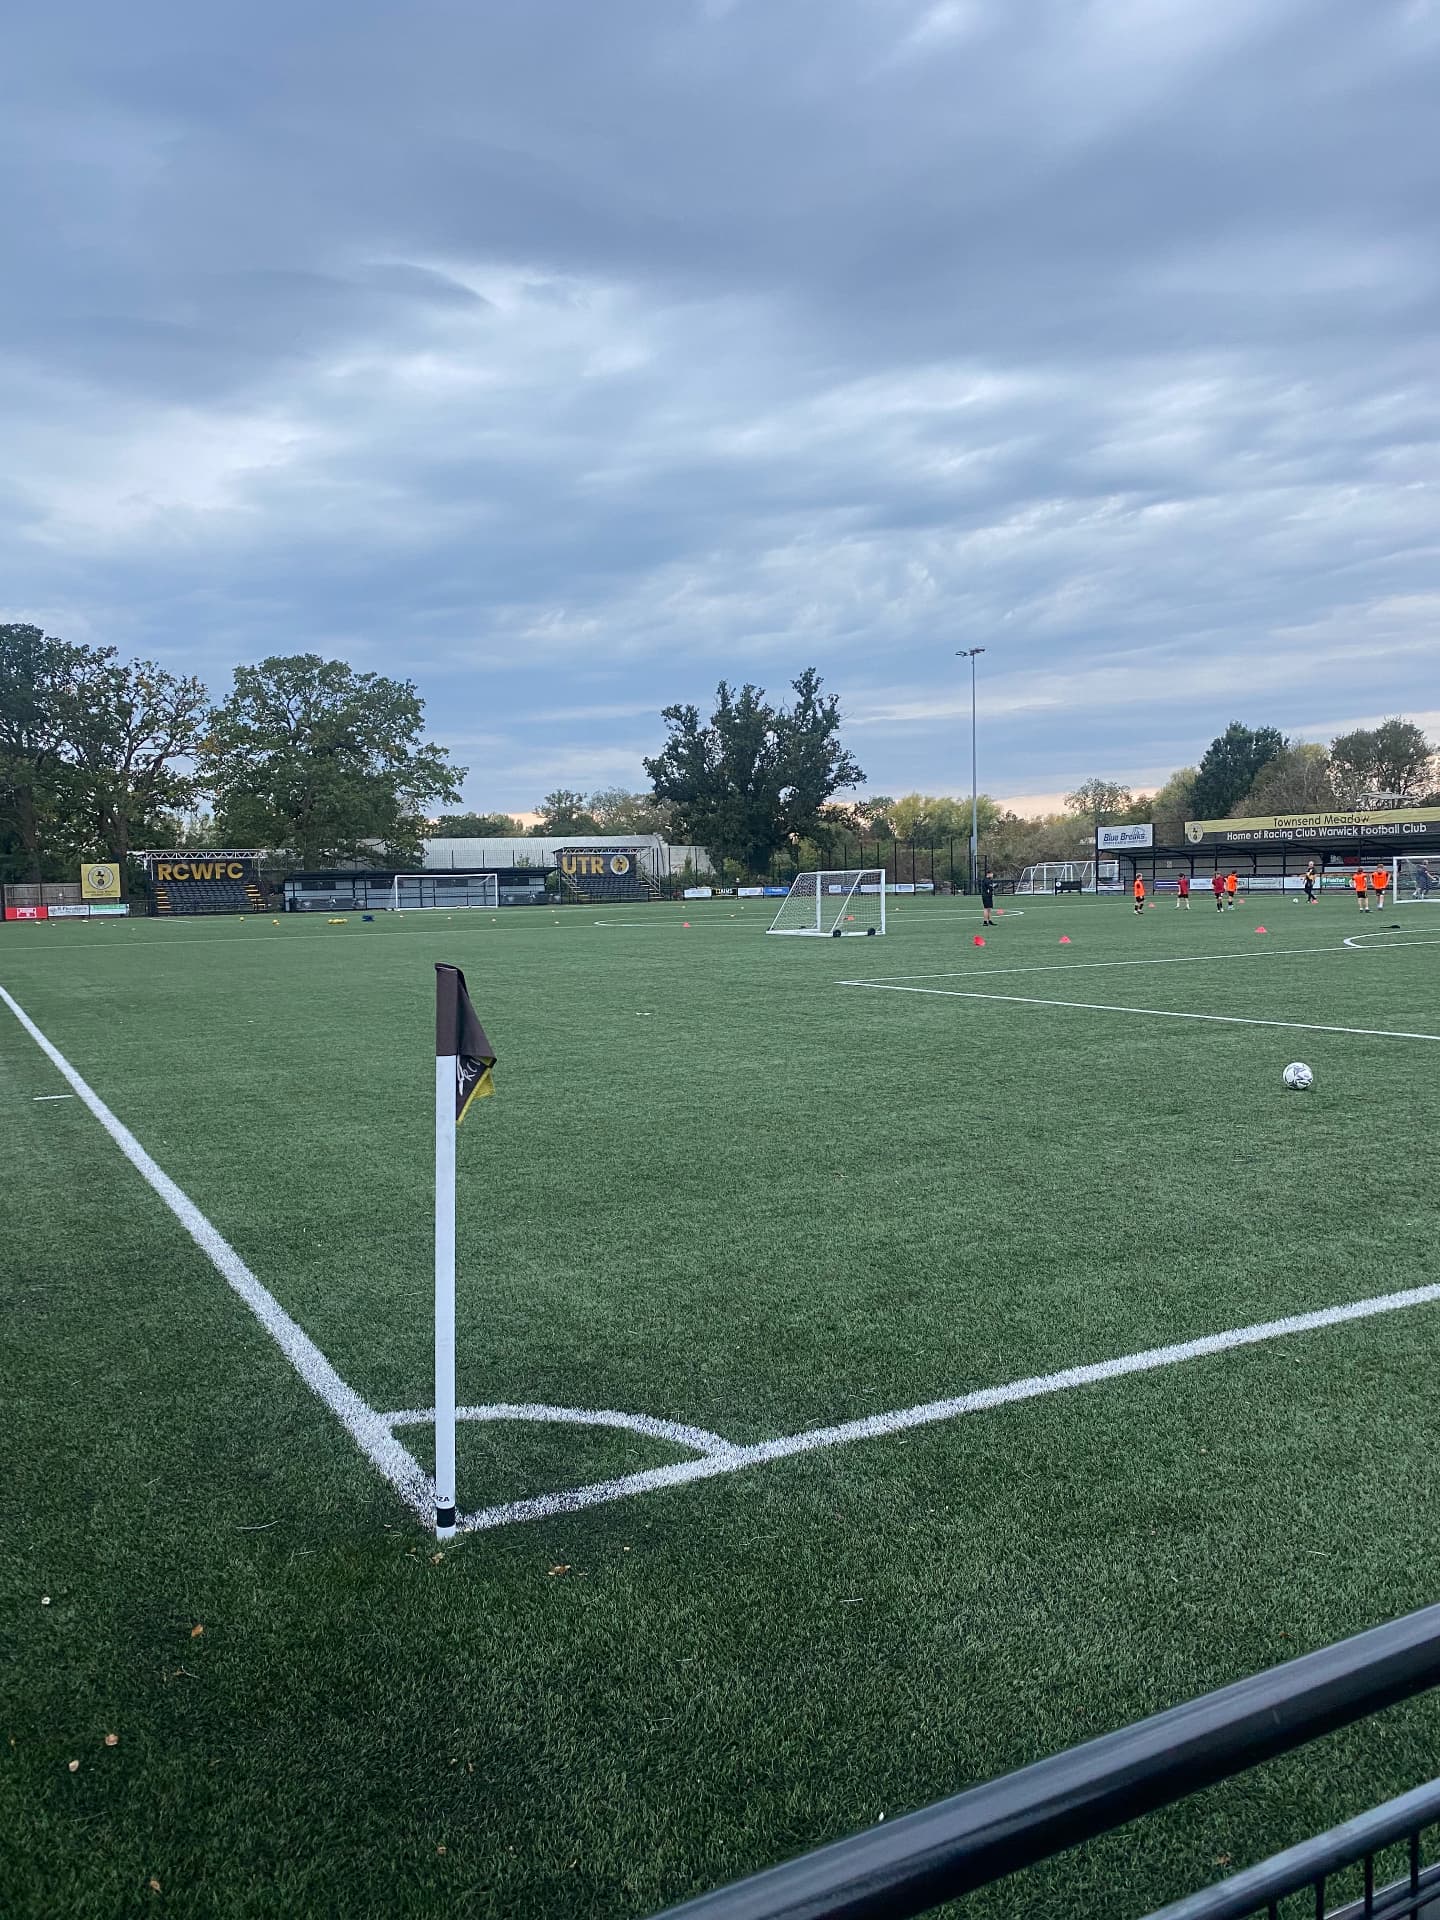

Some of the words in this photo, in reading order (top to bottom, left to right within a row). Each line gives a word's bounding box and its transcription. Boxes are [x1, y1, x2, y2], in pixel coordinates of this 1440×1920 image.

[1273, 815, 1321, 828] Townsend
[1323, 813, 1370, 825] Meadow
[1226, 831, 1252, 841] Home
[1253, 830, 1262, 839] of
[1263, 829, 1293, 840] Racing
[1295, 827, 1317, 838] Club
[1318, 825, 1359, 837] Warwick
[1360, 823, 1400, 835] Football
[1402, 822, 1427, 834] Club
[157, 862, 244, 881] RCWFC
[561, 855, 605, 875] UTR
